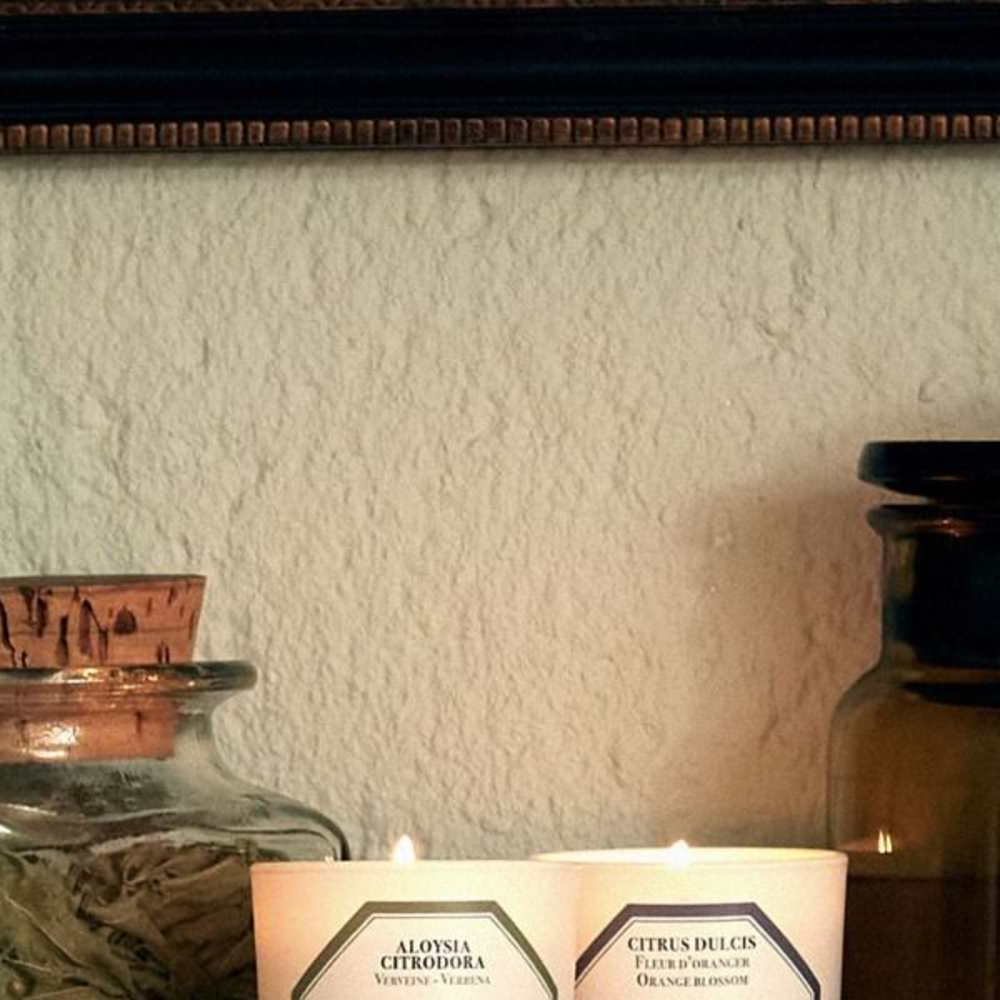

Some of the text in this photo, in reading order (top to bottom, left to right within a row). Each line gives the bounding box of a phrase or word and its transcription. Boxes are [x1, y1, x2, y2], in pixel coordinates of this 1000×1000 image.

[396, 939, 470, 953] ALOYSIA
[628, 935, 757, 951] CITRUS DULCIS
[381, 955, 485, 969] CITRODORA
